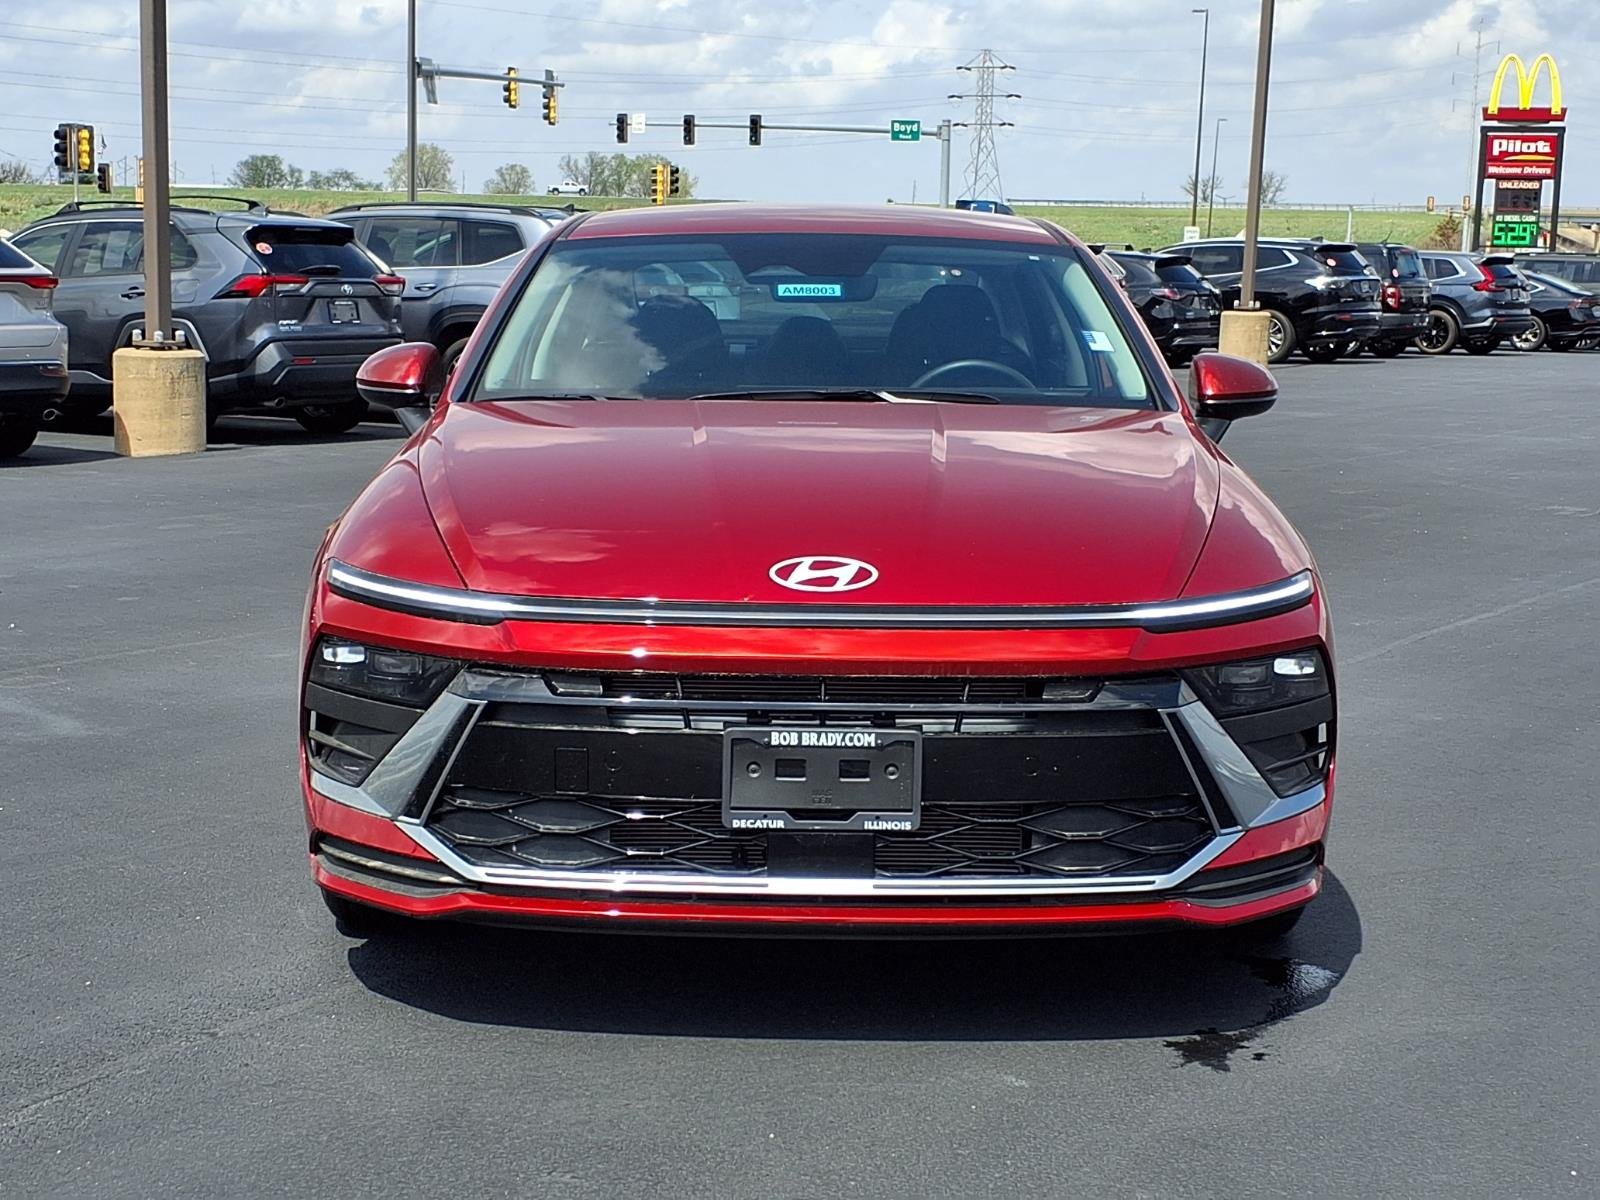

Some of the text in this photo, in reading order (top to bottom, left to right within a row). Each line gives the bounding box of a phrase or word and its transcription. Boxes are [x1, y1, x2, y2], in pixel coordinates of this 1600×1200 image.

[893, 122, 918, 134] Boyd
[1487, 166, 1552, 174] Welcome Drivers
[1498, 181, 1540, 189] UNLEADED
[782, 286, 836, 295] AM8003
[770, 731, 876, 747] BOB BRADY.COM
[732, 819, 785, 829] DECATUR
[863, 820, 912, 831] ILLINOIS
